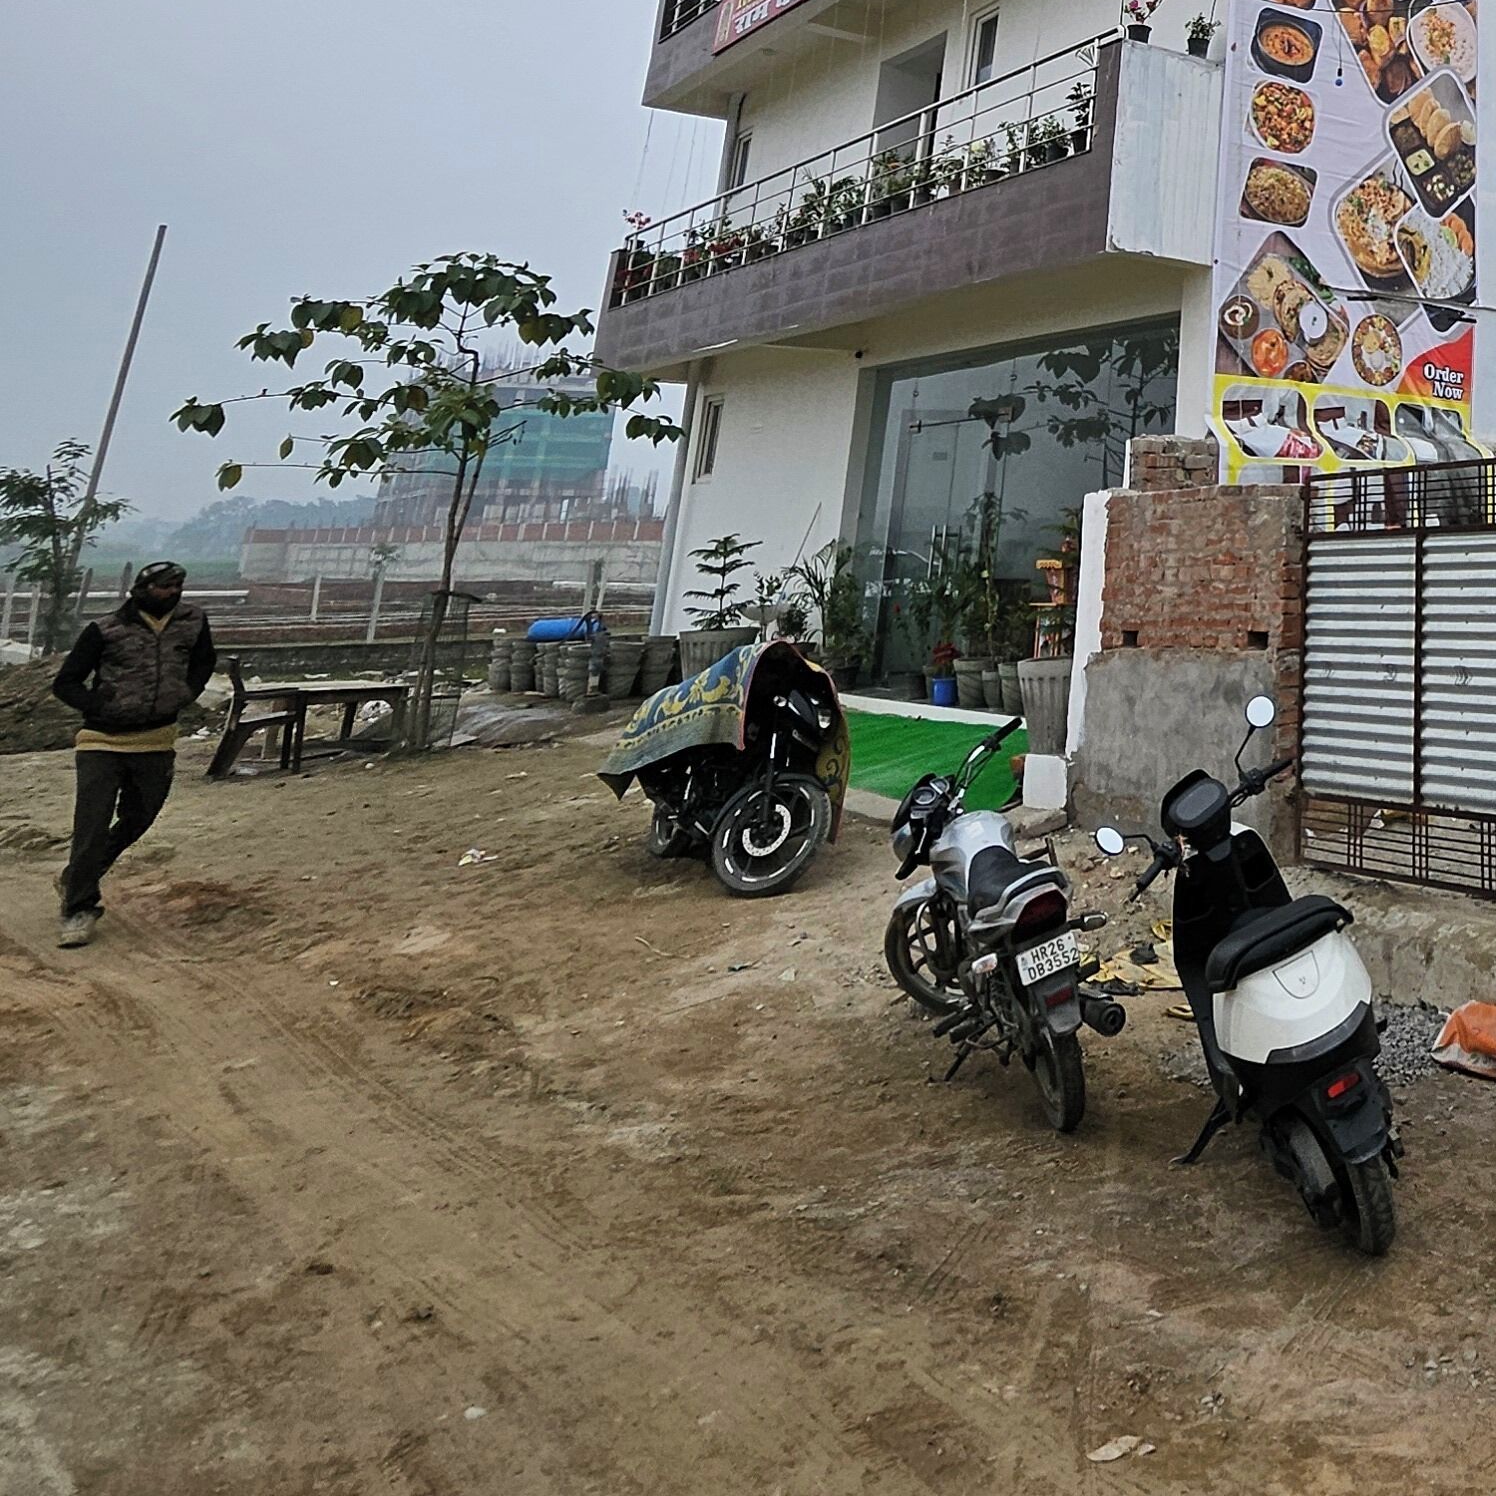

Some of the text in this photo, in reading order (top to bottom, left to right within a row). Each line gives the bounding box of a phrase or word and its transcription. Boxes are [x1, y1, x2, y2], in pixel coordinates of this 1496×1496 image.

[1423, 364, 1464, 384] Order
[1432, 380, 1464, 400] Now
[1031, 939, 1065, 963] HR26
[1028, 948, 1079, 980] DB3552
